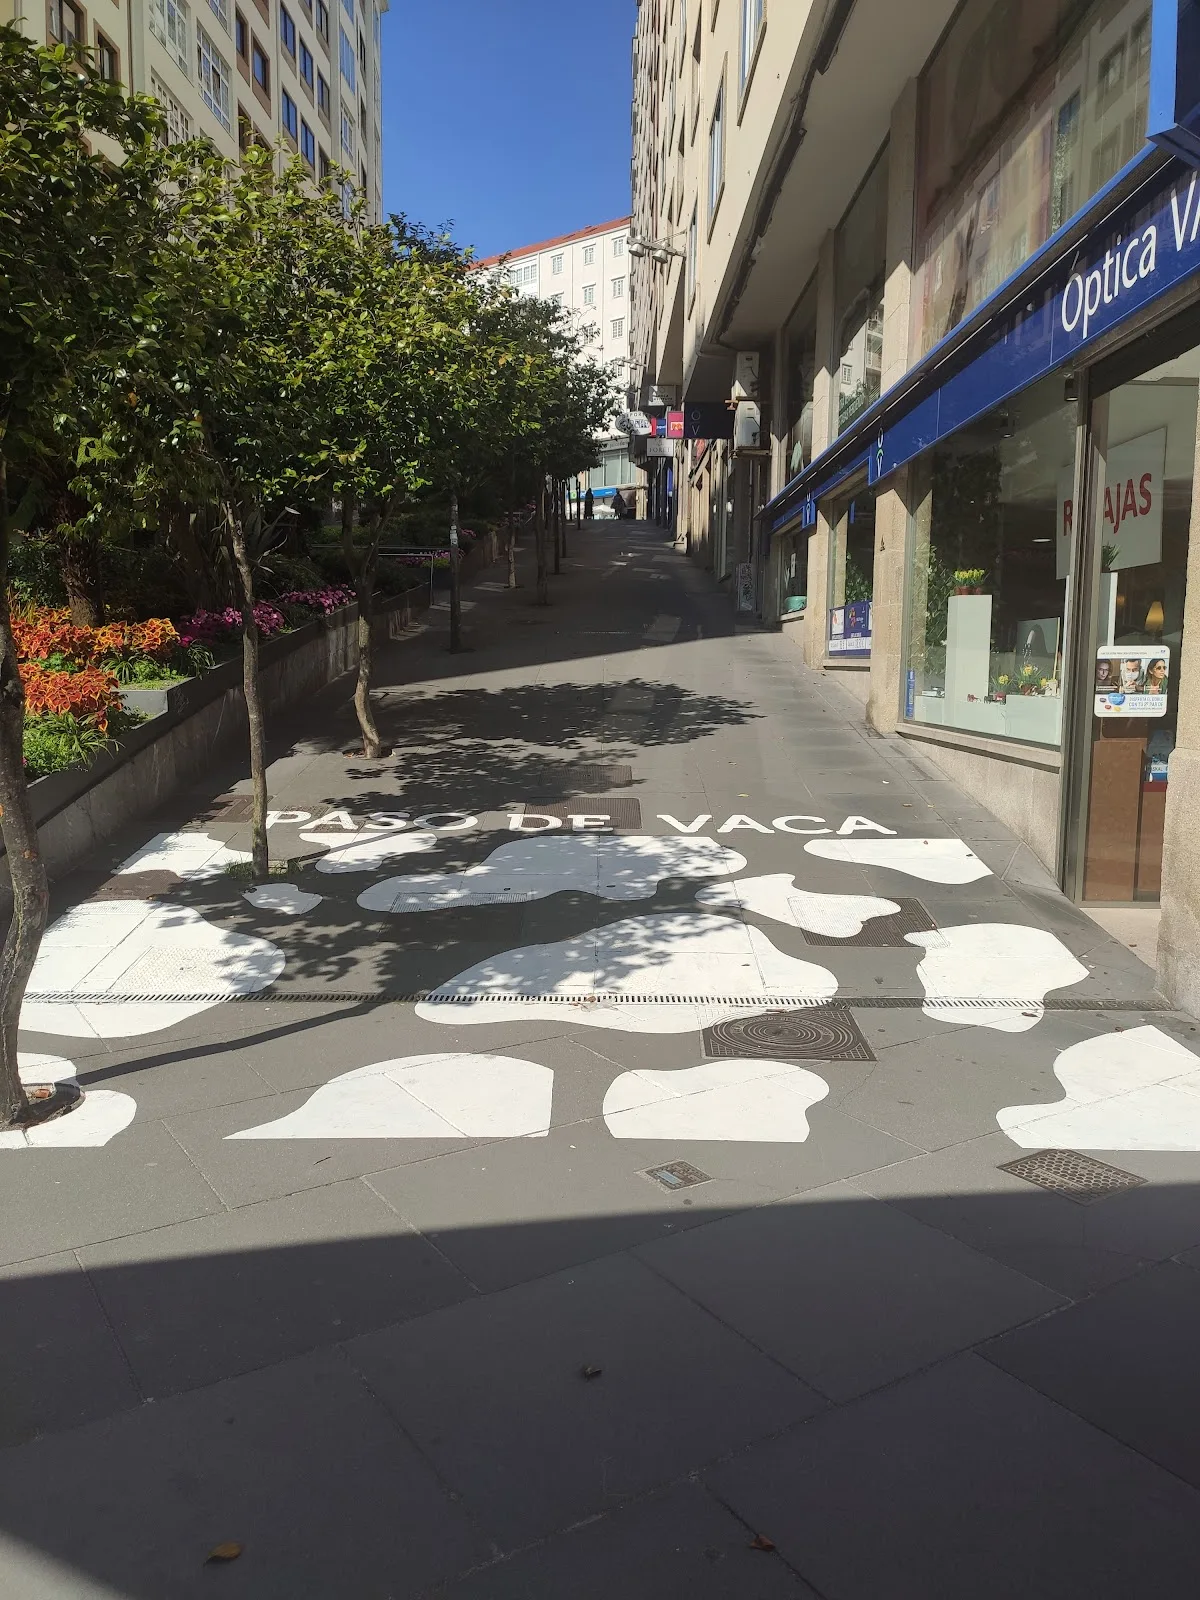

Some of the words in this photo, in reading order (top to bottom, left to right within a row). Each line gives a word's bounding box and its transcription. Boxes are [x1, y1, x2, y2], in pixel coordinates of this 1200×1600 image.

[1063, 472, 1152, 537] RAJAS
[265, 809, 478, 831] PASO
[506, 813, 614, 832] DE
[656, 813, 898, 835] VACA
